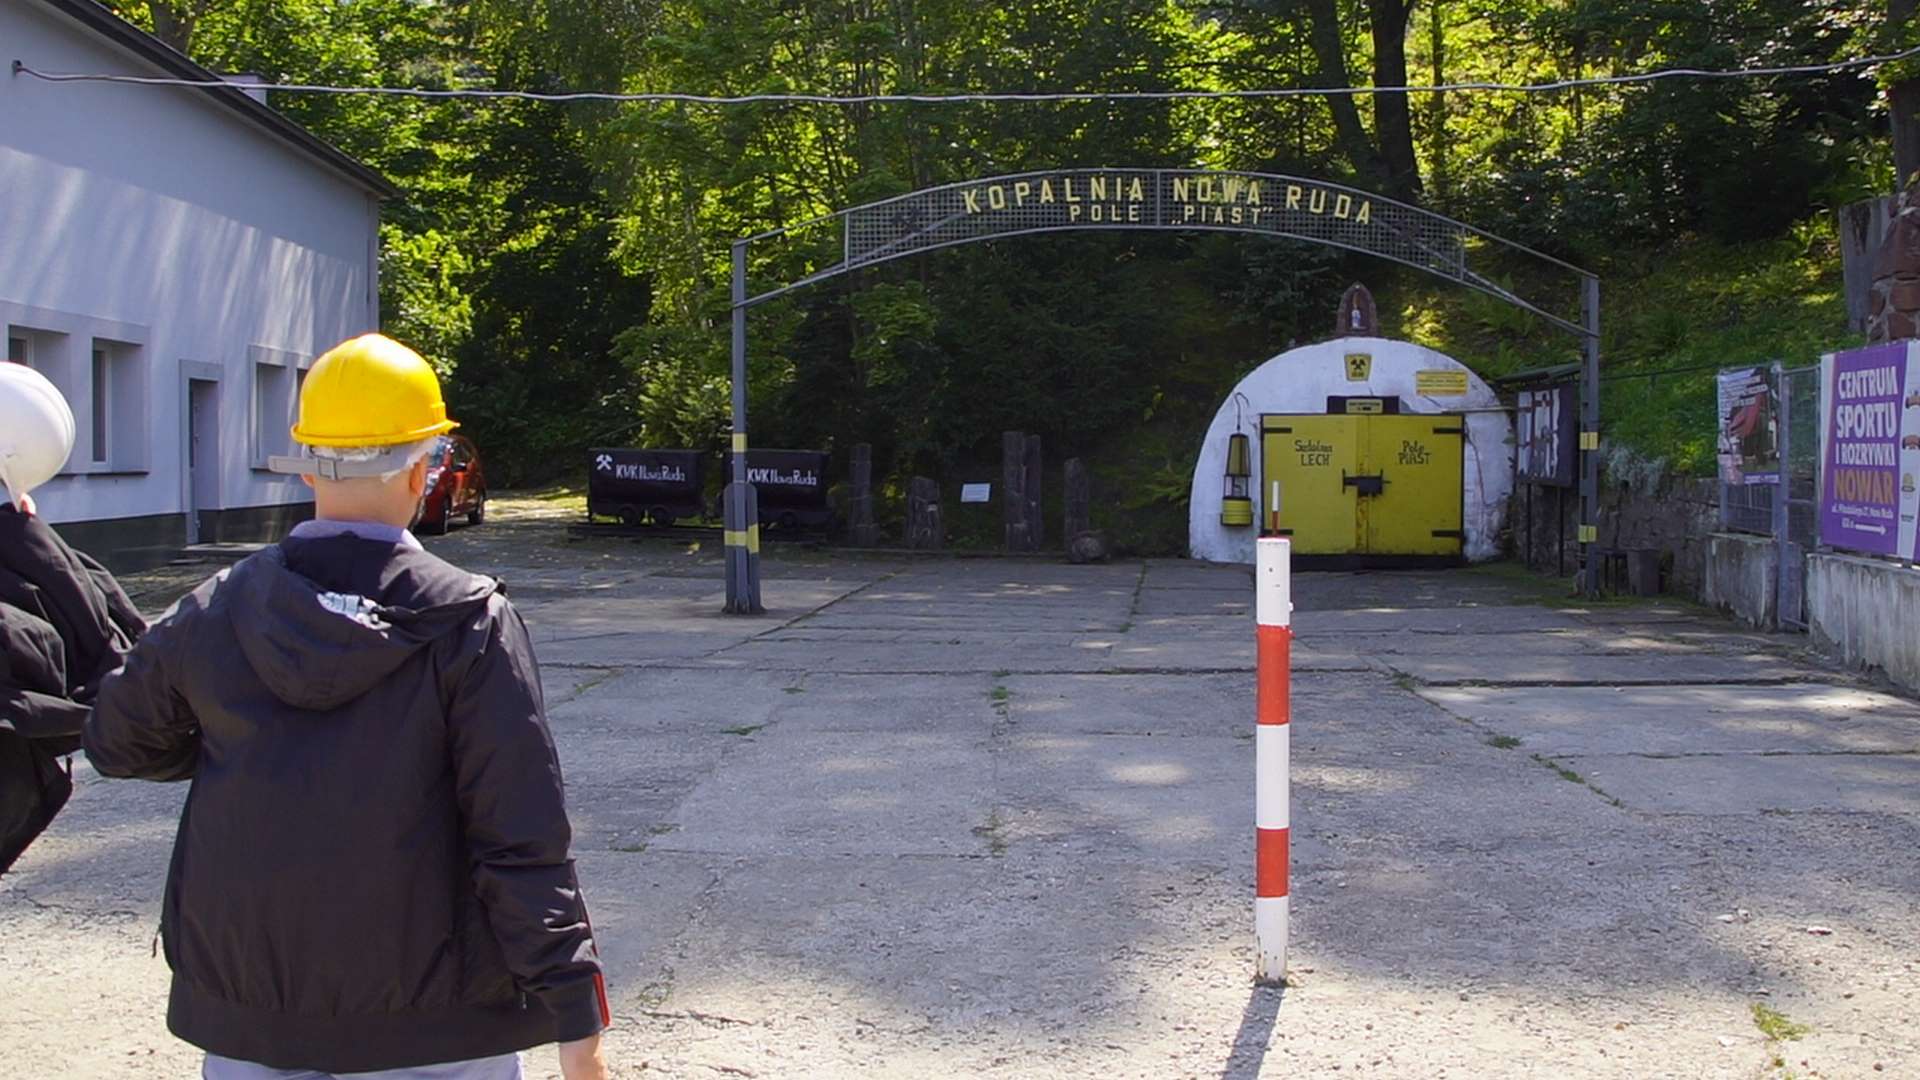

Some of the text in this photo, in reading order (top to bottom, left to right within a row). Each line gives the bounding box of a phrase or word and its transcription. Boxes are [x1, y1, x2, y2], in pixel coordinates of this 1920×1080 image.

[961, 177, 1370, 224] KOPALNIA NOWA RUDA
[1070, 205, 1139, 222] POLE
[1838, 366, 1898, 398] CENTRUM
[1836, 402, 1897, 438] SPORTU
[1301, 454, 1329, 466] LECH
[1835, 443, 1896, 466] I ROZRYWKI
[1834, 469, 1894, 505] NOWAR
